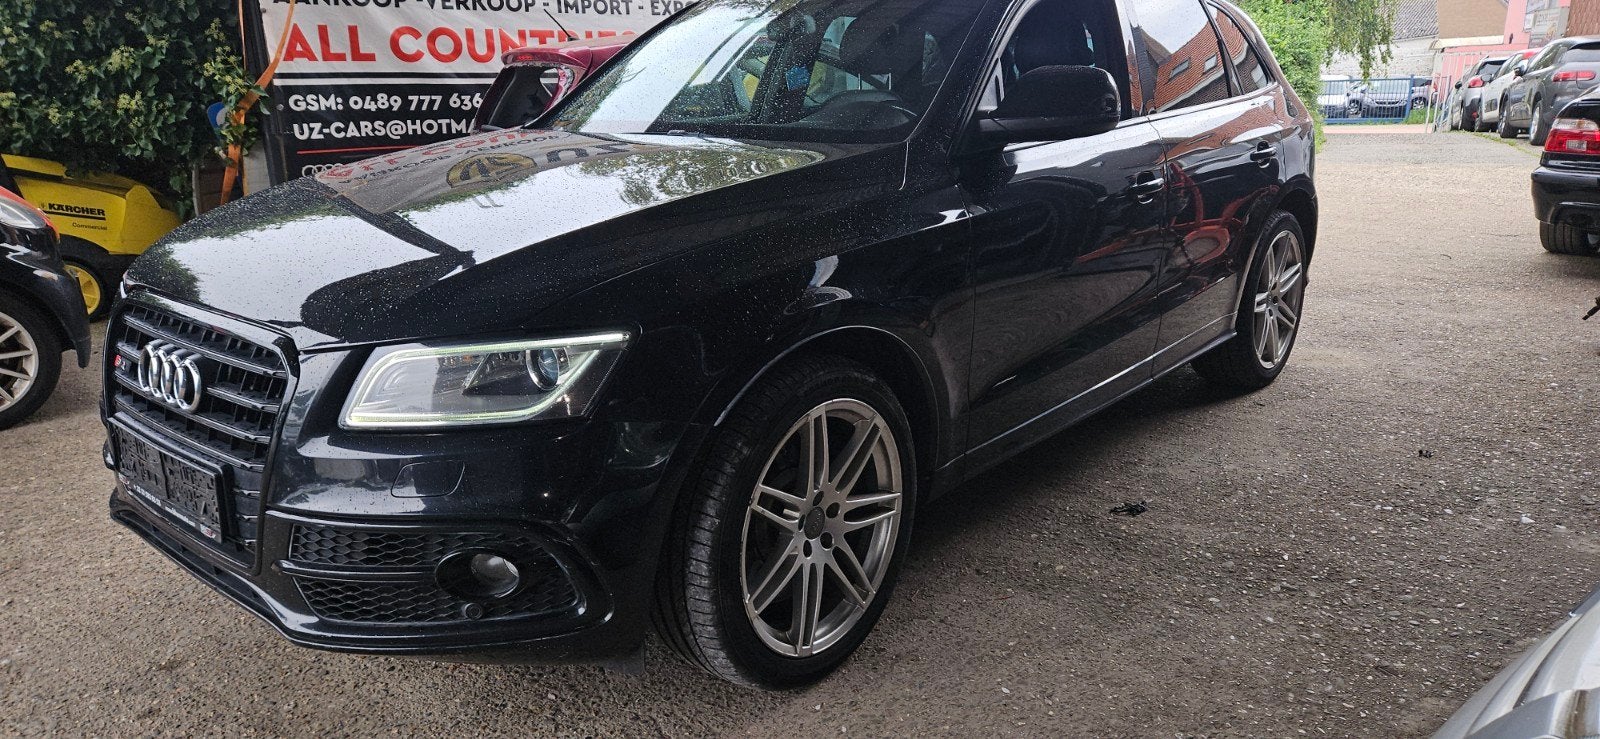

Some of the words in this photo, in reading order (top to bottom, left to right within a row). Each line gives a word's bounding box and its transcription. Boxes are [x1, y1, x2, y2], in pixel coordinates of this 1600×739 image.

[557, 0, 632, 15] IMPORT
[283, 23, 376, 61] ALL
[390, 25, 636, 63] COUNT
[288, 94, 344, 112] GSM:
[349, 92, 402, 111] 0489
[408, 95, 443, 111] 777
[449, 93, 484, 111] 636
[72, 222, 108, 231] Commercial
